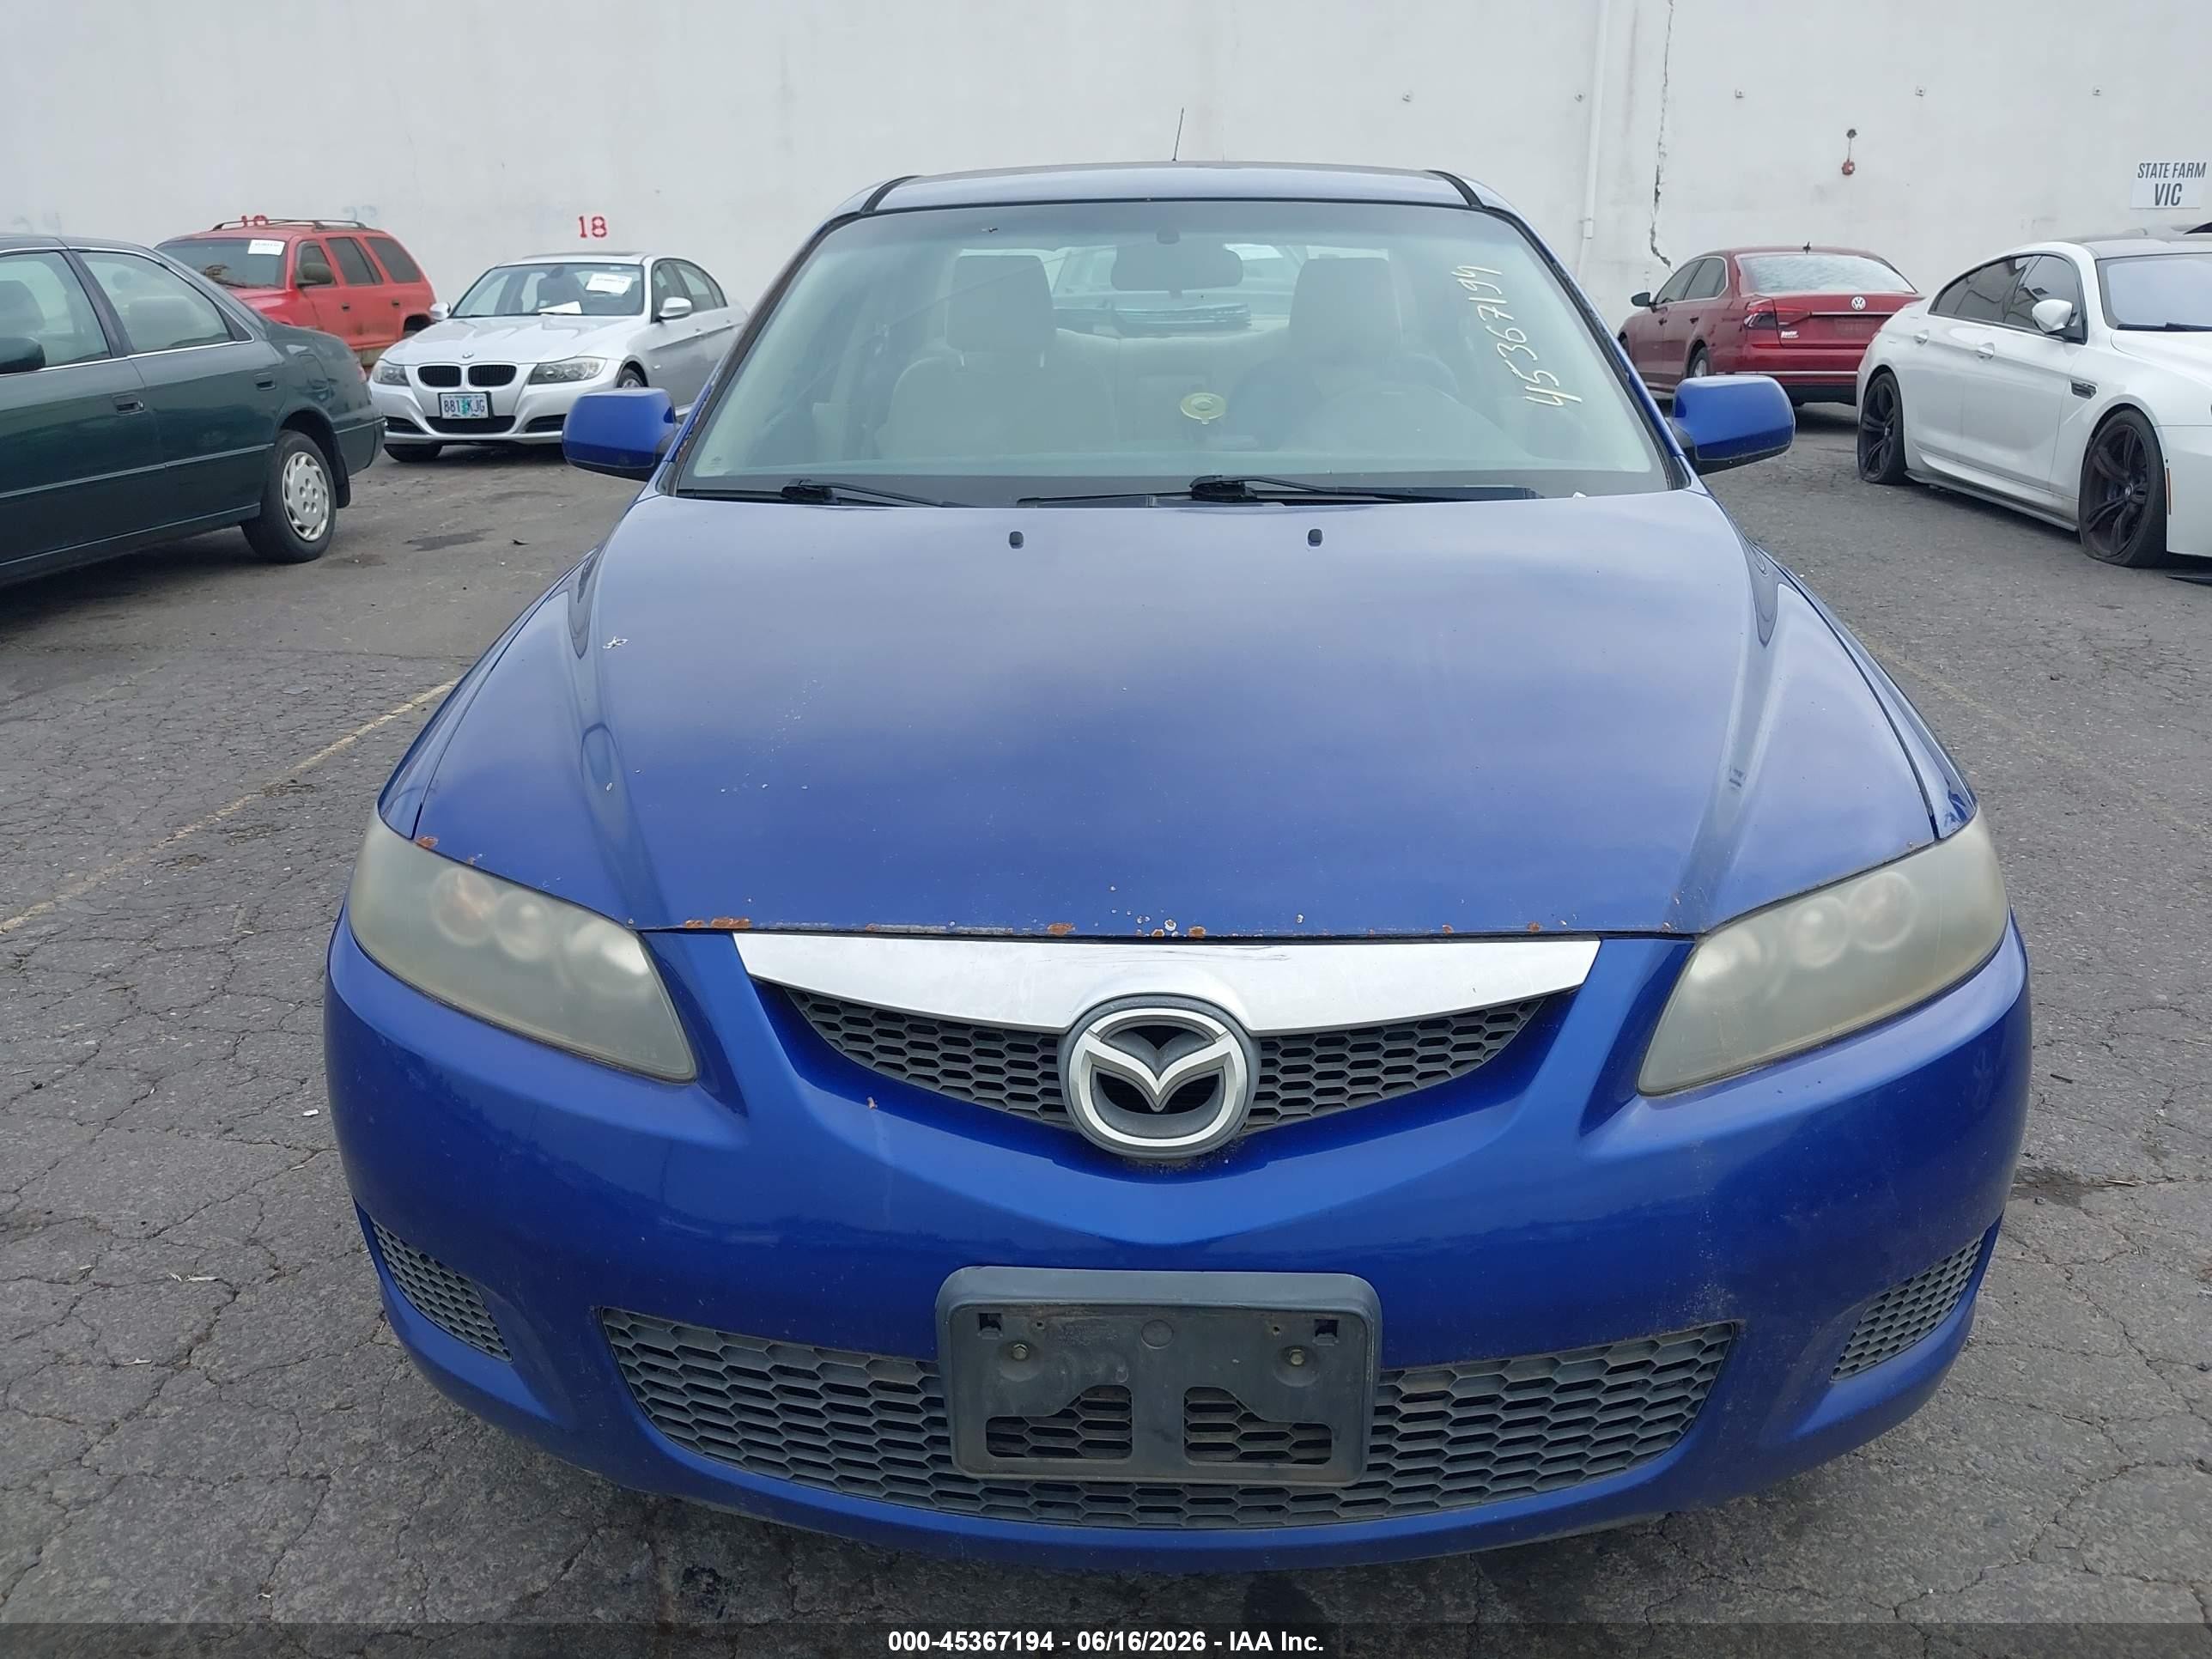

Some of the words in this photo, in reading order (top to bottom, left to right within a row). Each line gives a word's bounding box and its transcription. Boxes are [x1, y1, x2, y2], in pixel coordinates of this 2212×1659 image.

[2137, 162, 2171, 179] STATE
[2172, 162, 2207, 179] FARM
[2154, 183, 2183, 206] VIC
[579, 216, 607, 238] 18
[1451, 265, 1583, 406] 45367194
[444, 399, 460, 412] 881
